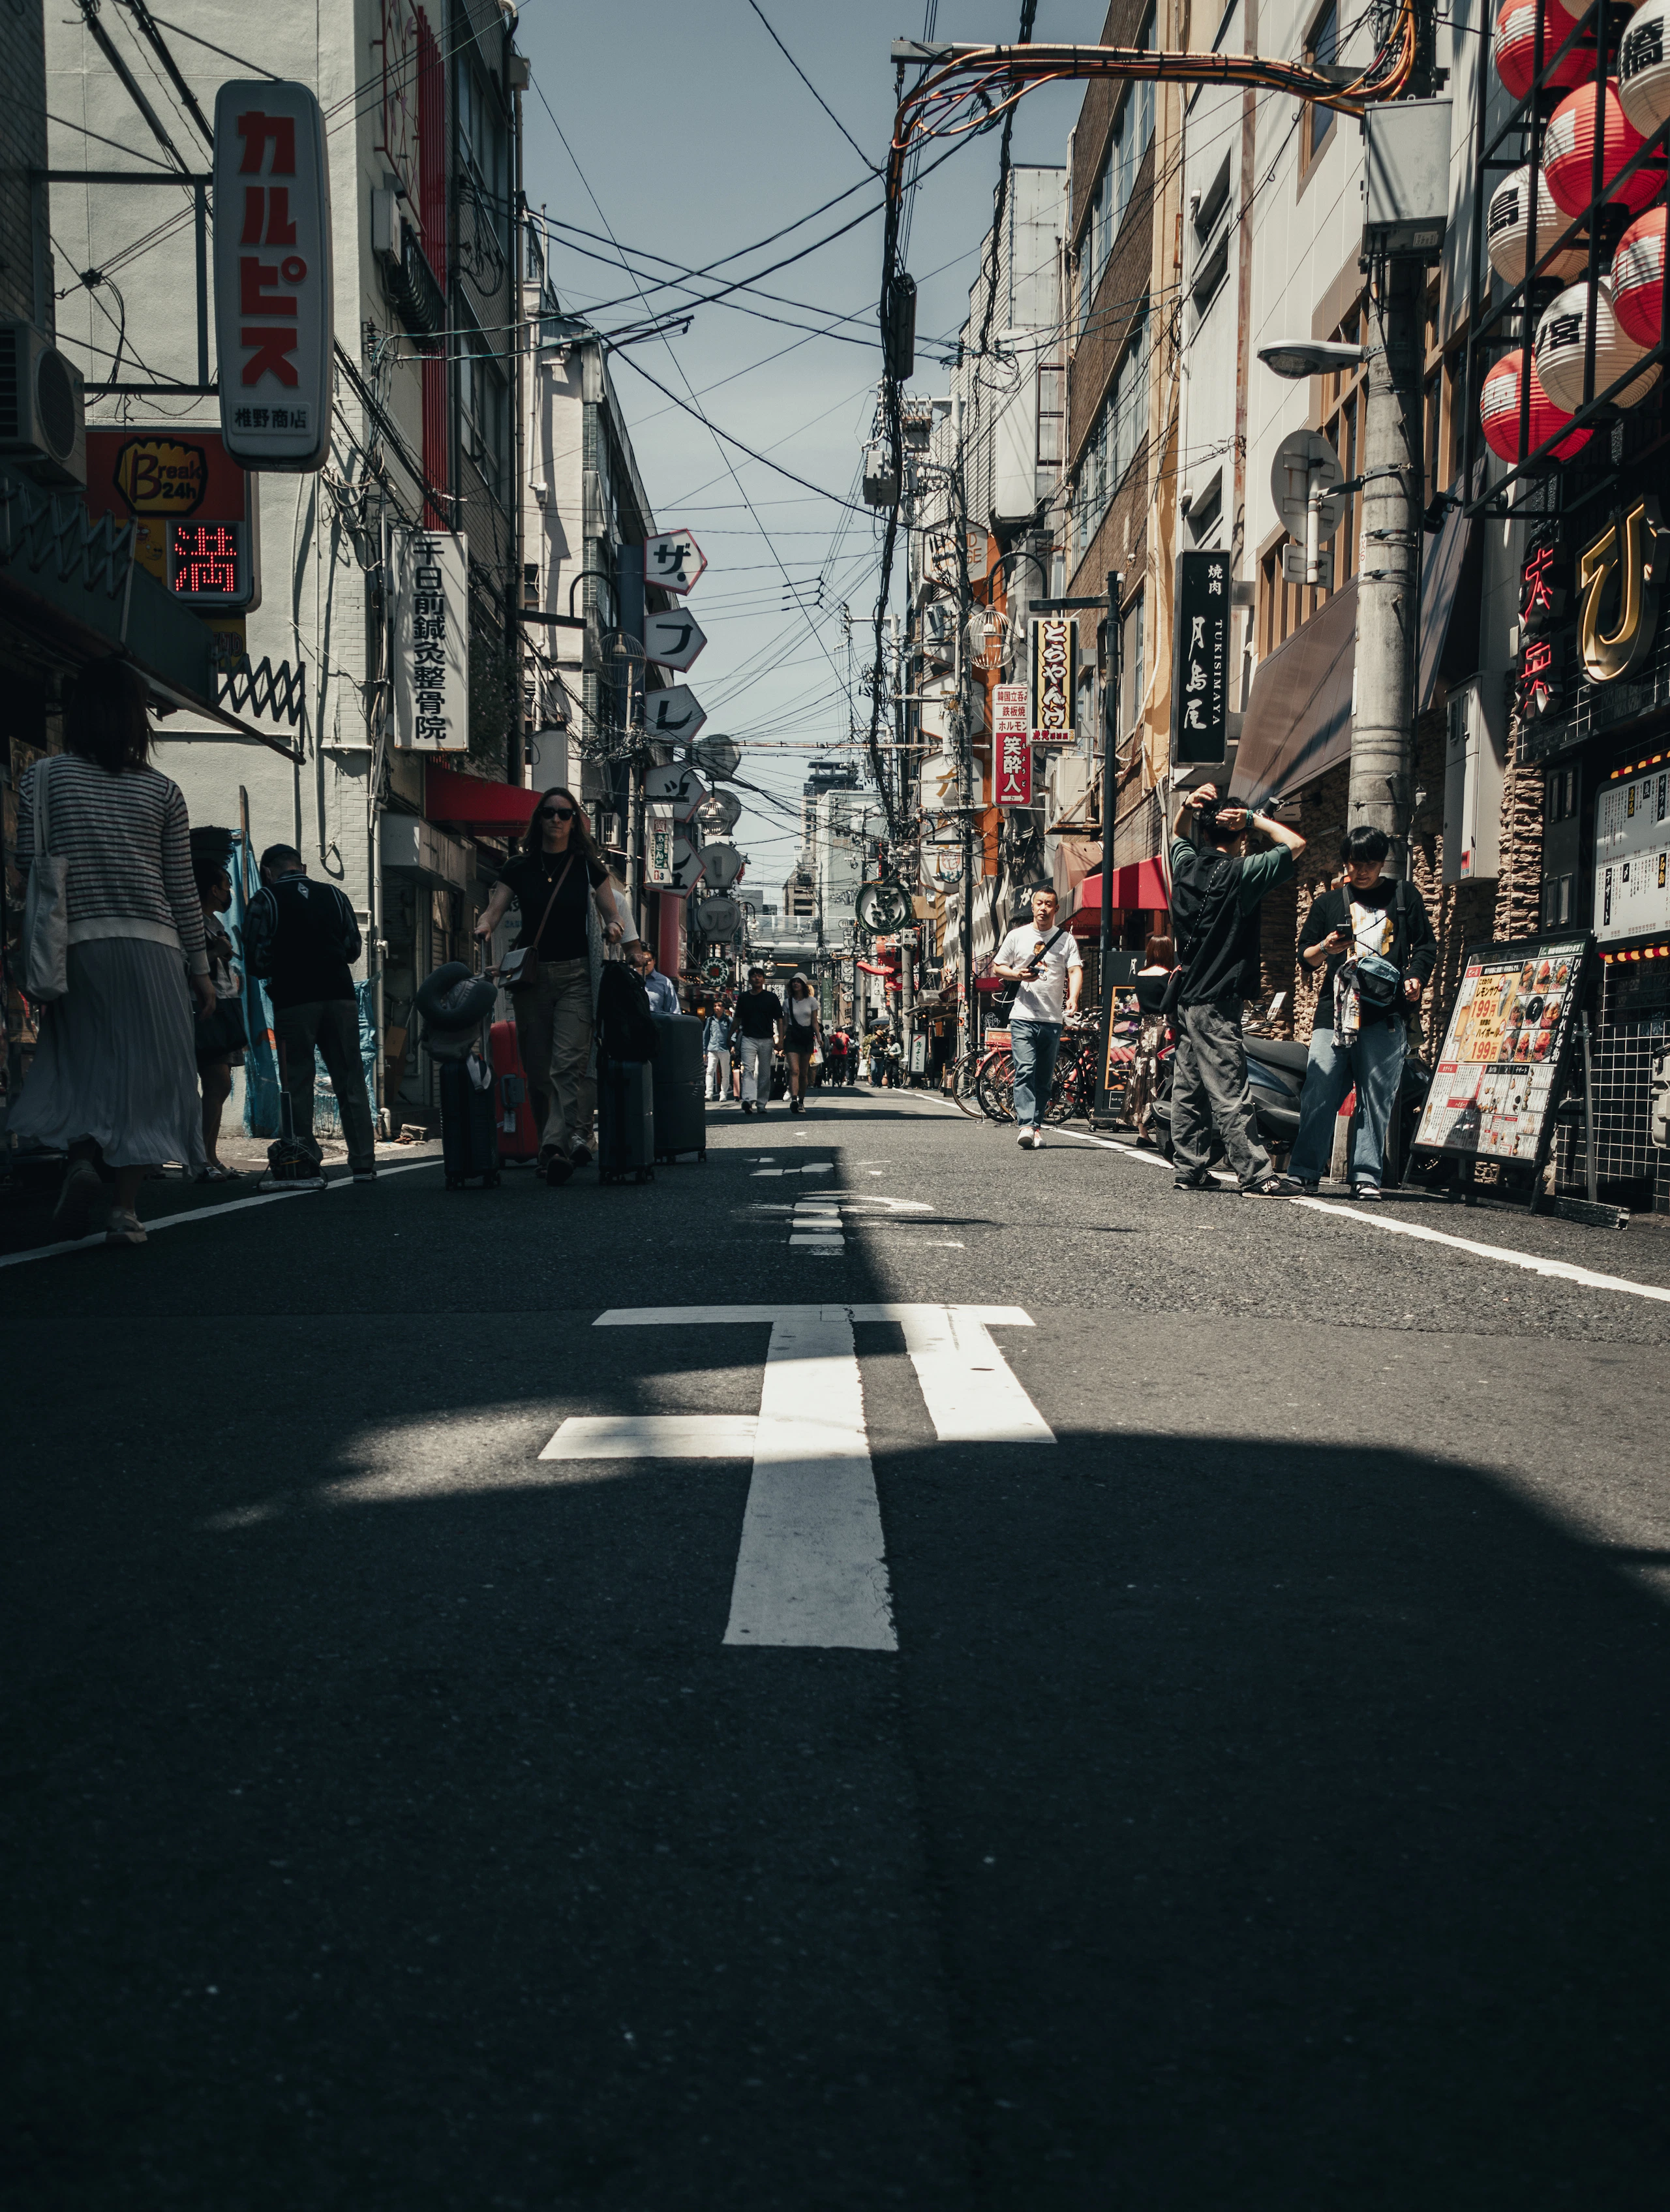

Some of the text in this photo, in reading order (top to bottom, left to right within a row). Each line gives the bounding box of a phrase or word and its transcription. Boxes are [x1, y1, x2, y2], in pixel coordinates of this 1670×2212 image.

[237, 111, 307, 386] カルピス
[130, 450, 202, 500] Break
[162, 480, 196, 499] 24h
[175, 527, 237, 592] 満
[1208, 564, 1223, 595] 焼肉
[413, 542, 446, 740] 千日前鍼灸整骨院
[1042, 623, 1067, 727] とらやんけ
[1213, 619, 1222, 726] TUKISIMAYA
[1003, 706, 1025, 716] 鉄板焼
[1003, 736, 1022, 793] 笑酔人
[656, 835, 664, 868] あきんど
[1472, 1000, 1496, 1018] 199円
[1551, 959, 1581, 1062] ひとめぼれ名物
[1472, 1041, 1497, 1060] 199円
